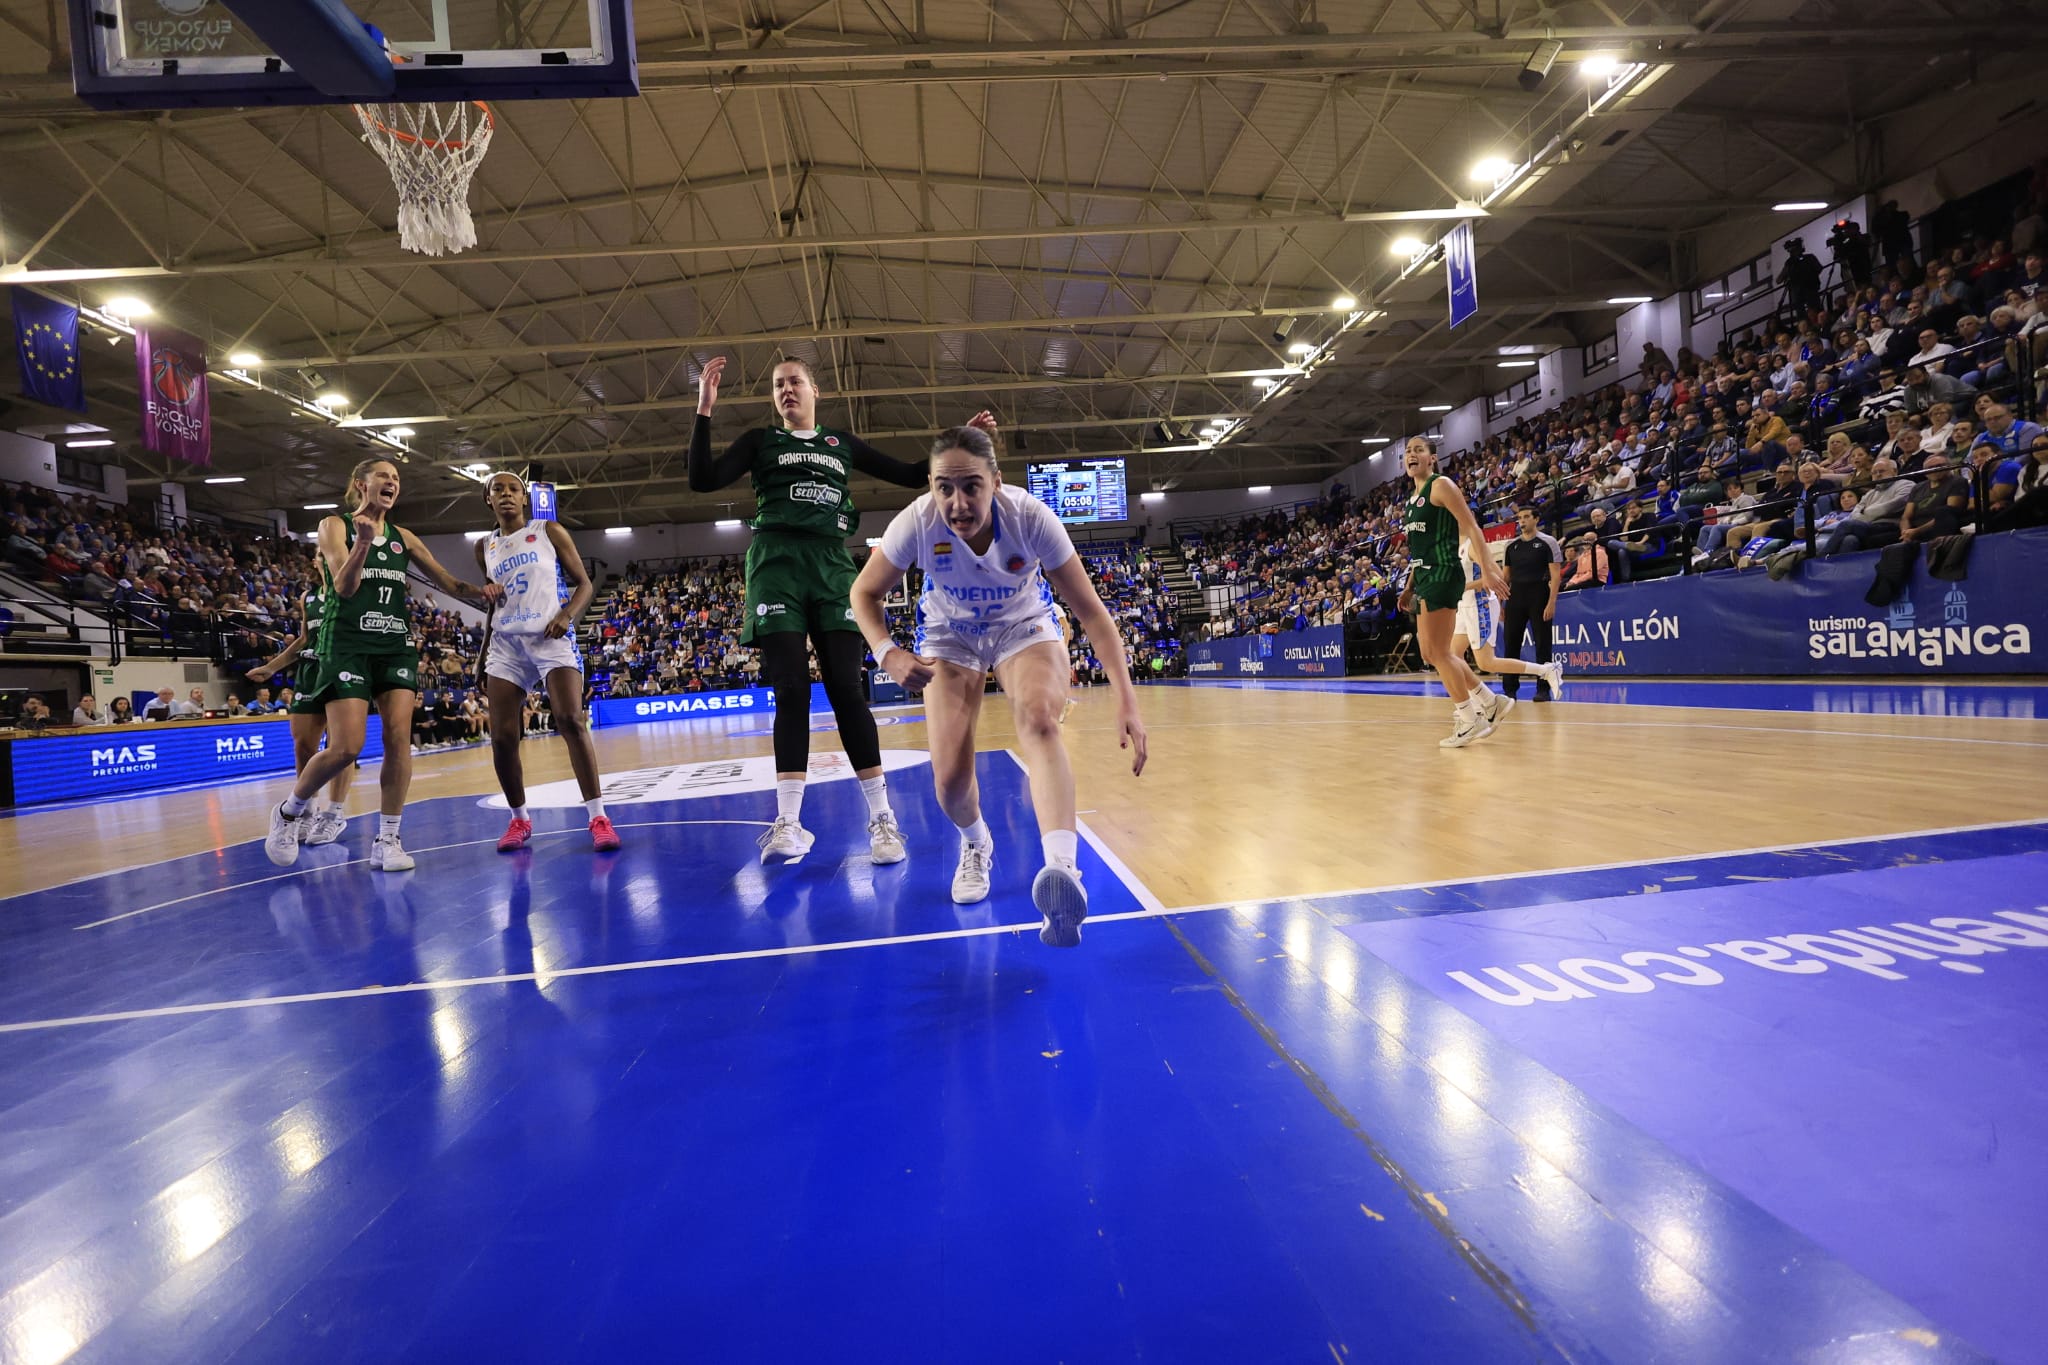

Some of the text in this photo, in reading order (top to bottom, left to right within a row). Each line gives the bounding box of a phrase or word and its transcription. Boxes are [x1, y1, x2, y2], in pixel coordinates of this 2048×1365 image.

[147, 401, 202, 430] EUROCUP
[539, 492, 549, 508] 8
[1064, 496, 1093, 507] 05:08
[378, 586, 393, 605] 17
[1597, 621, 1612, 648] Y
[1619, 609, 1680, 642] LEÓN
[1808, 616, 1867, 632] turismo
[1284, 648, 1313, 660] CASTILLA
[1320, 640, 1341, 658] LEÓN
[1568, 650, 1627, 670] IMPULSA
[635, 694, 754, 716] SPMAS.ES
[215, 735, 264, 754] MAS
[91, 744, 157, 767] MAS
[216, 750, 266, 762] PREVENCIÓN
[92, 761, 158, 777] PREVENCIÓN
